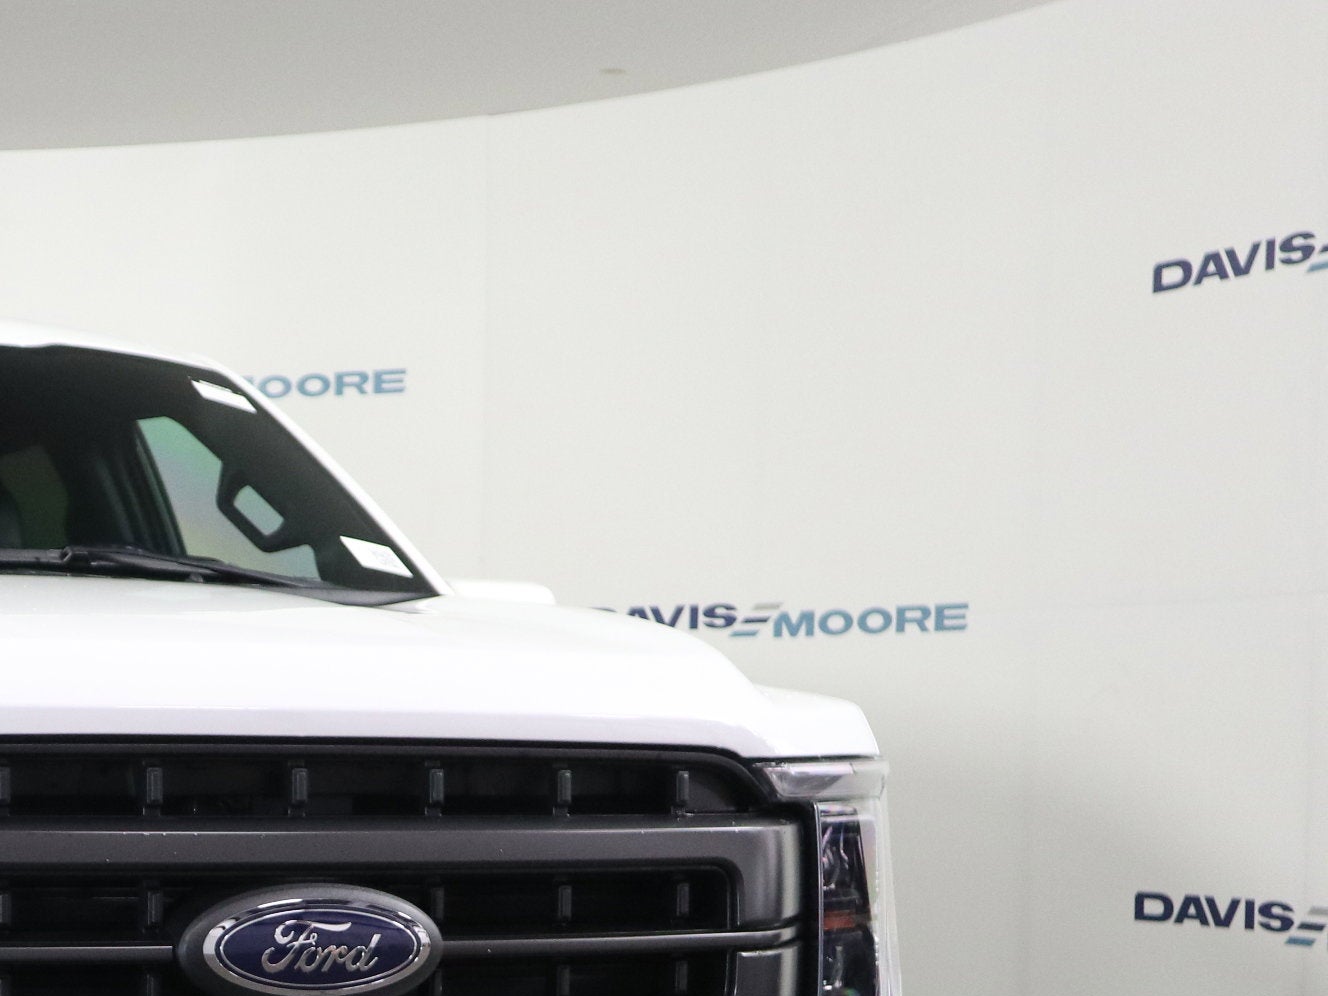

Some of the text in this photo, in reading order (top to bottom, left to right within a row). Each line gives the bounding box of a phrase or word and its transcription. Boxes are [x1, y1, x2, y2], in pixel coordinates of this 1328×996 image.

[1152, 230, 1317, 293] DAVIS
[244, 368, 407, 398] OORE
[772, 602, 970, 638] MOORE
[1134, 890, 1296, 932] DAVIS
[260, 919, 383, 974] Ford
